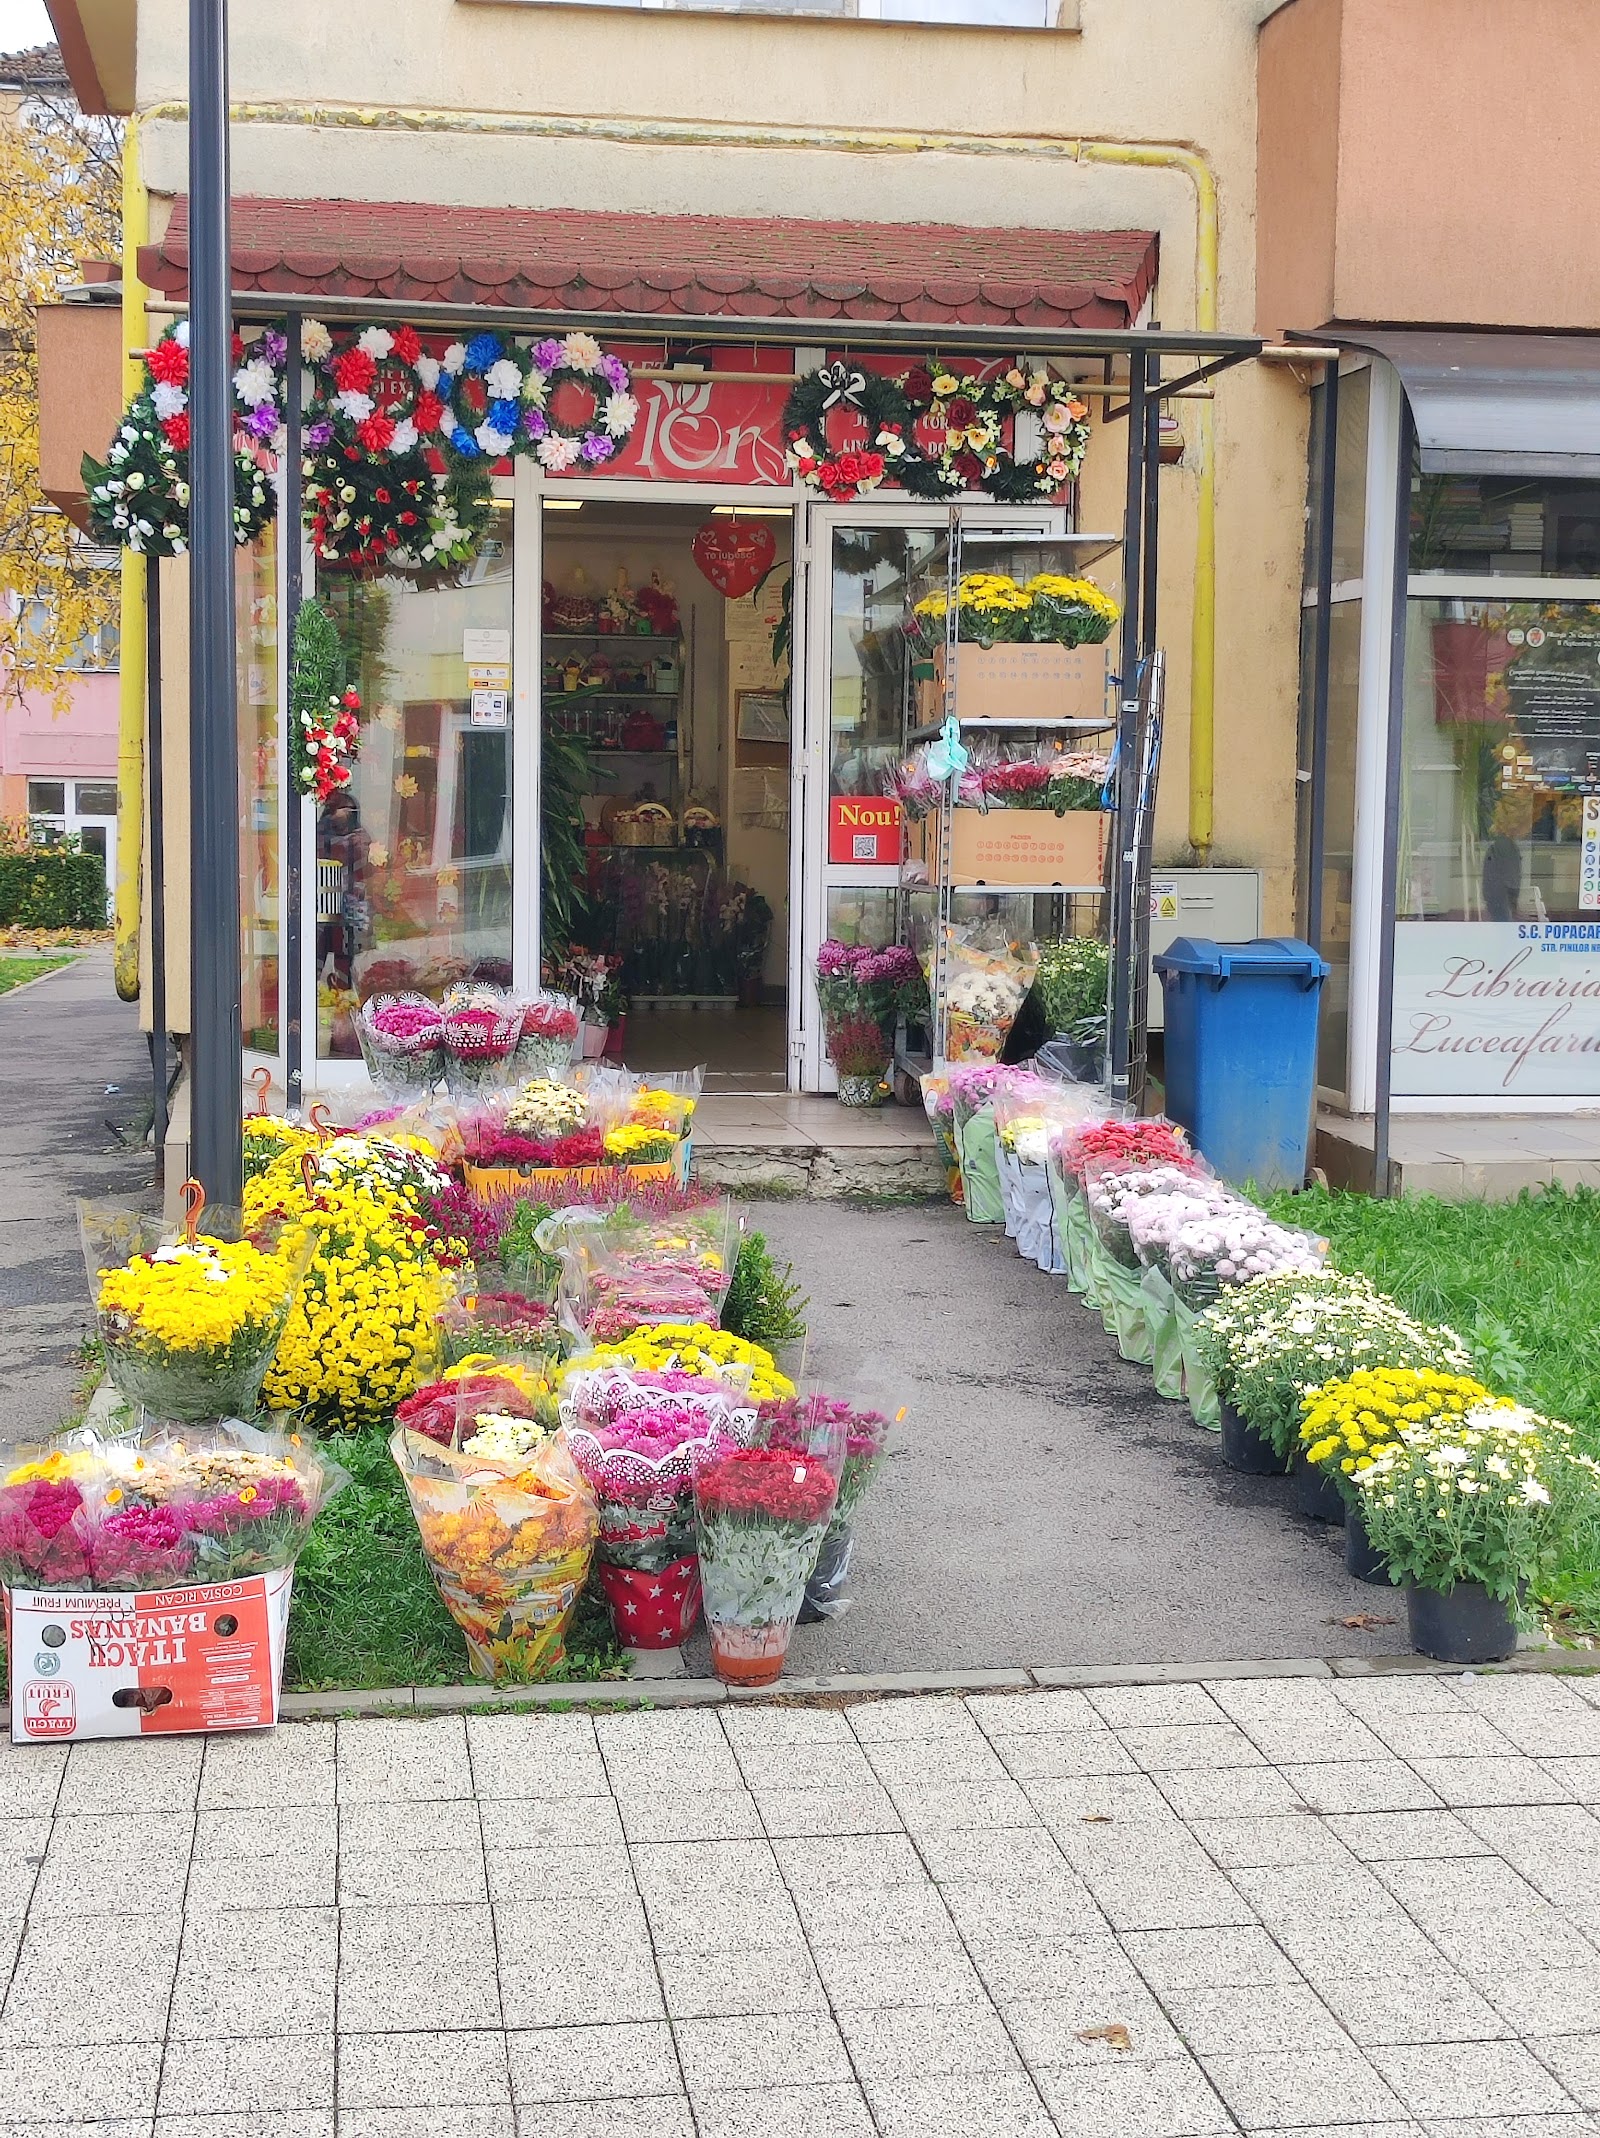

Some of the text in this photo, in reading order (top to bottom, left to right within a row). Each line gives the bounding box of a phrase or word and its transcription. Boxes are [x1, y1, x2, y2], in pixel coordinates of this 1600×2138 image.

[838, 804, 900, 826] Nou!
[1518, 924, 1541, 939] S.C.
[32, 1596, 121, 1608] PREMIUM FRUIT
[156, 1584, 243, 1606] COSTA RICAN
[70, 1612, 208, 1639] BANANAS
[89, 1638, 187, 1666] ITACU
[28, 1688, 70, 1698] FRUIT
[29, 1718, 72, 1728] ITACU
